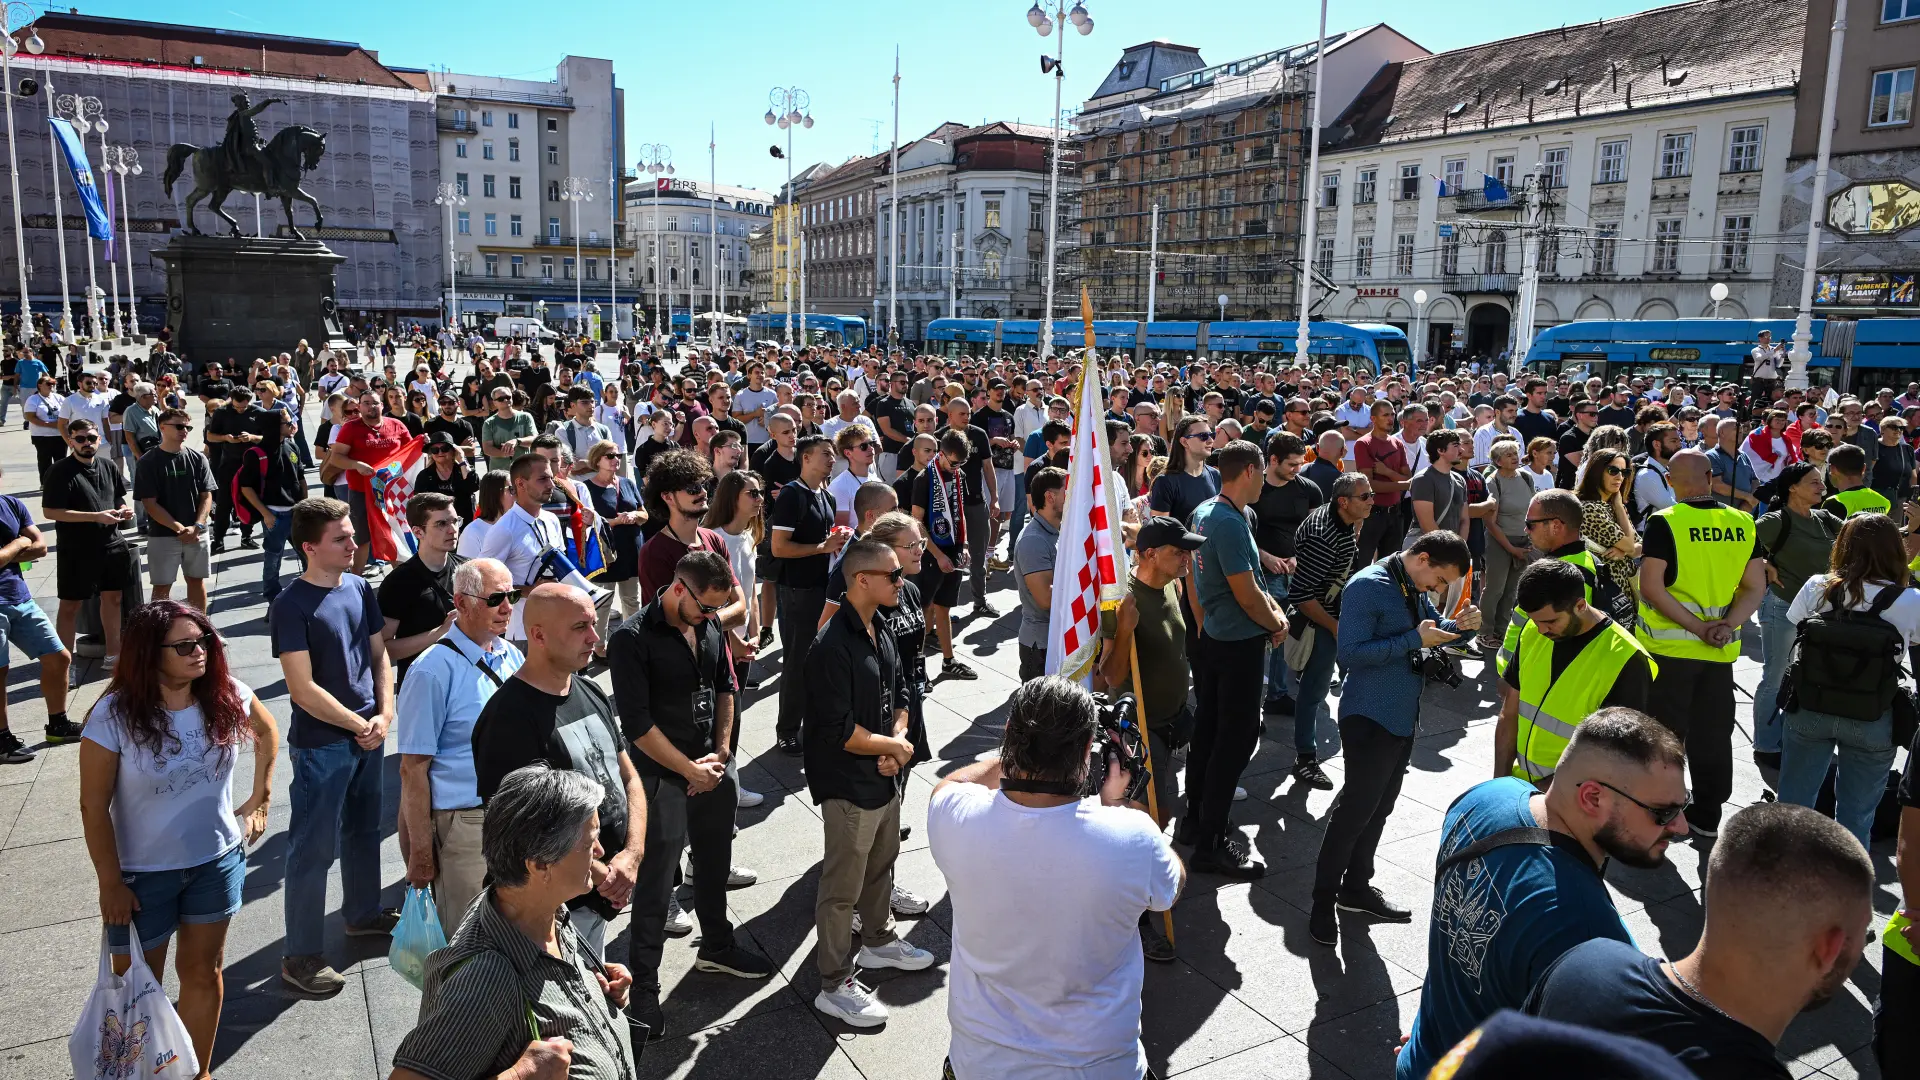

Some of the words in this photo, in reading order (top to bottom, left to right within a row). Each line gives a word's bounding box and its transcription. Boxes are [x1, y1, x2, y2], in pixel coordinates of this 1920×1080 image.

[673, 180, 697, 190] HPB
[1854, 282, 1899, 290] DIMENZIA
[1357, 288, 1399, 296] PAN-PEK
[1846, 289, 1880, 297] ZABAVE!
[1689, 527, 1746, 542] REDAR
[155, 1049, 174, 1066] dm
